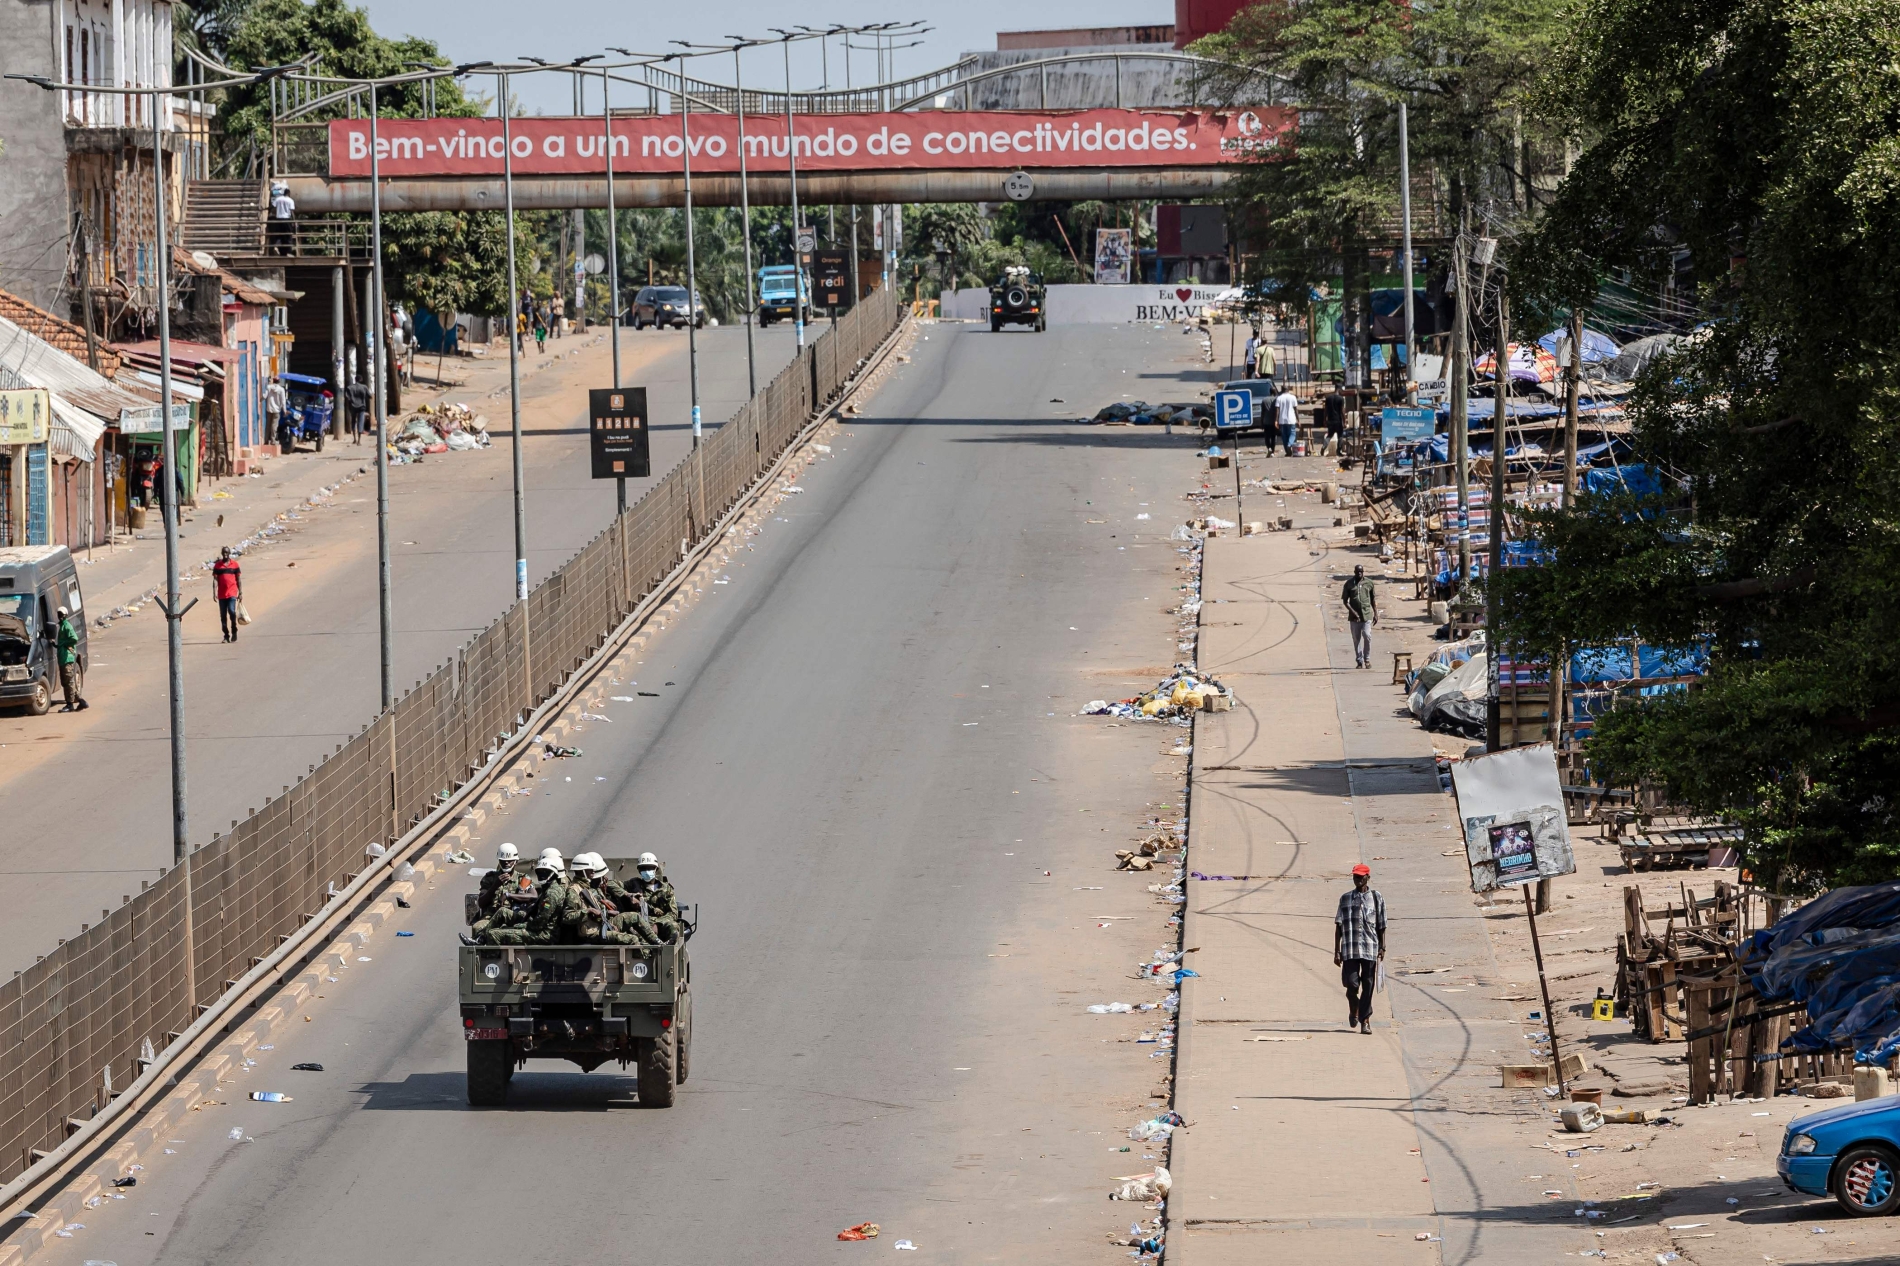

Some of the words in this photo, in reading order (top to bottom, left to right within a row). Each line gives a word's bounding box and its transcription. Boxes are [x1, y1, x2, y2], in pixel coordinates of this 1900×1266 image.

[542, 135, 565, 158] a
[576, 135, 630, 158] um
[641, 134, 728, 158] novo
[737, 126, 858, 158] mundo
[866, 126, 912, 156] de
[922, 121, 1197, 155] conectividades.
[1159, 290, 1174, 300] Eu
[1223, 394, 1244, 424] P
